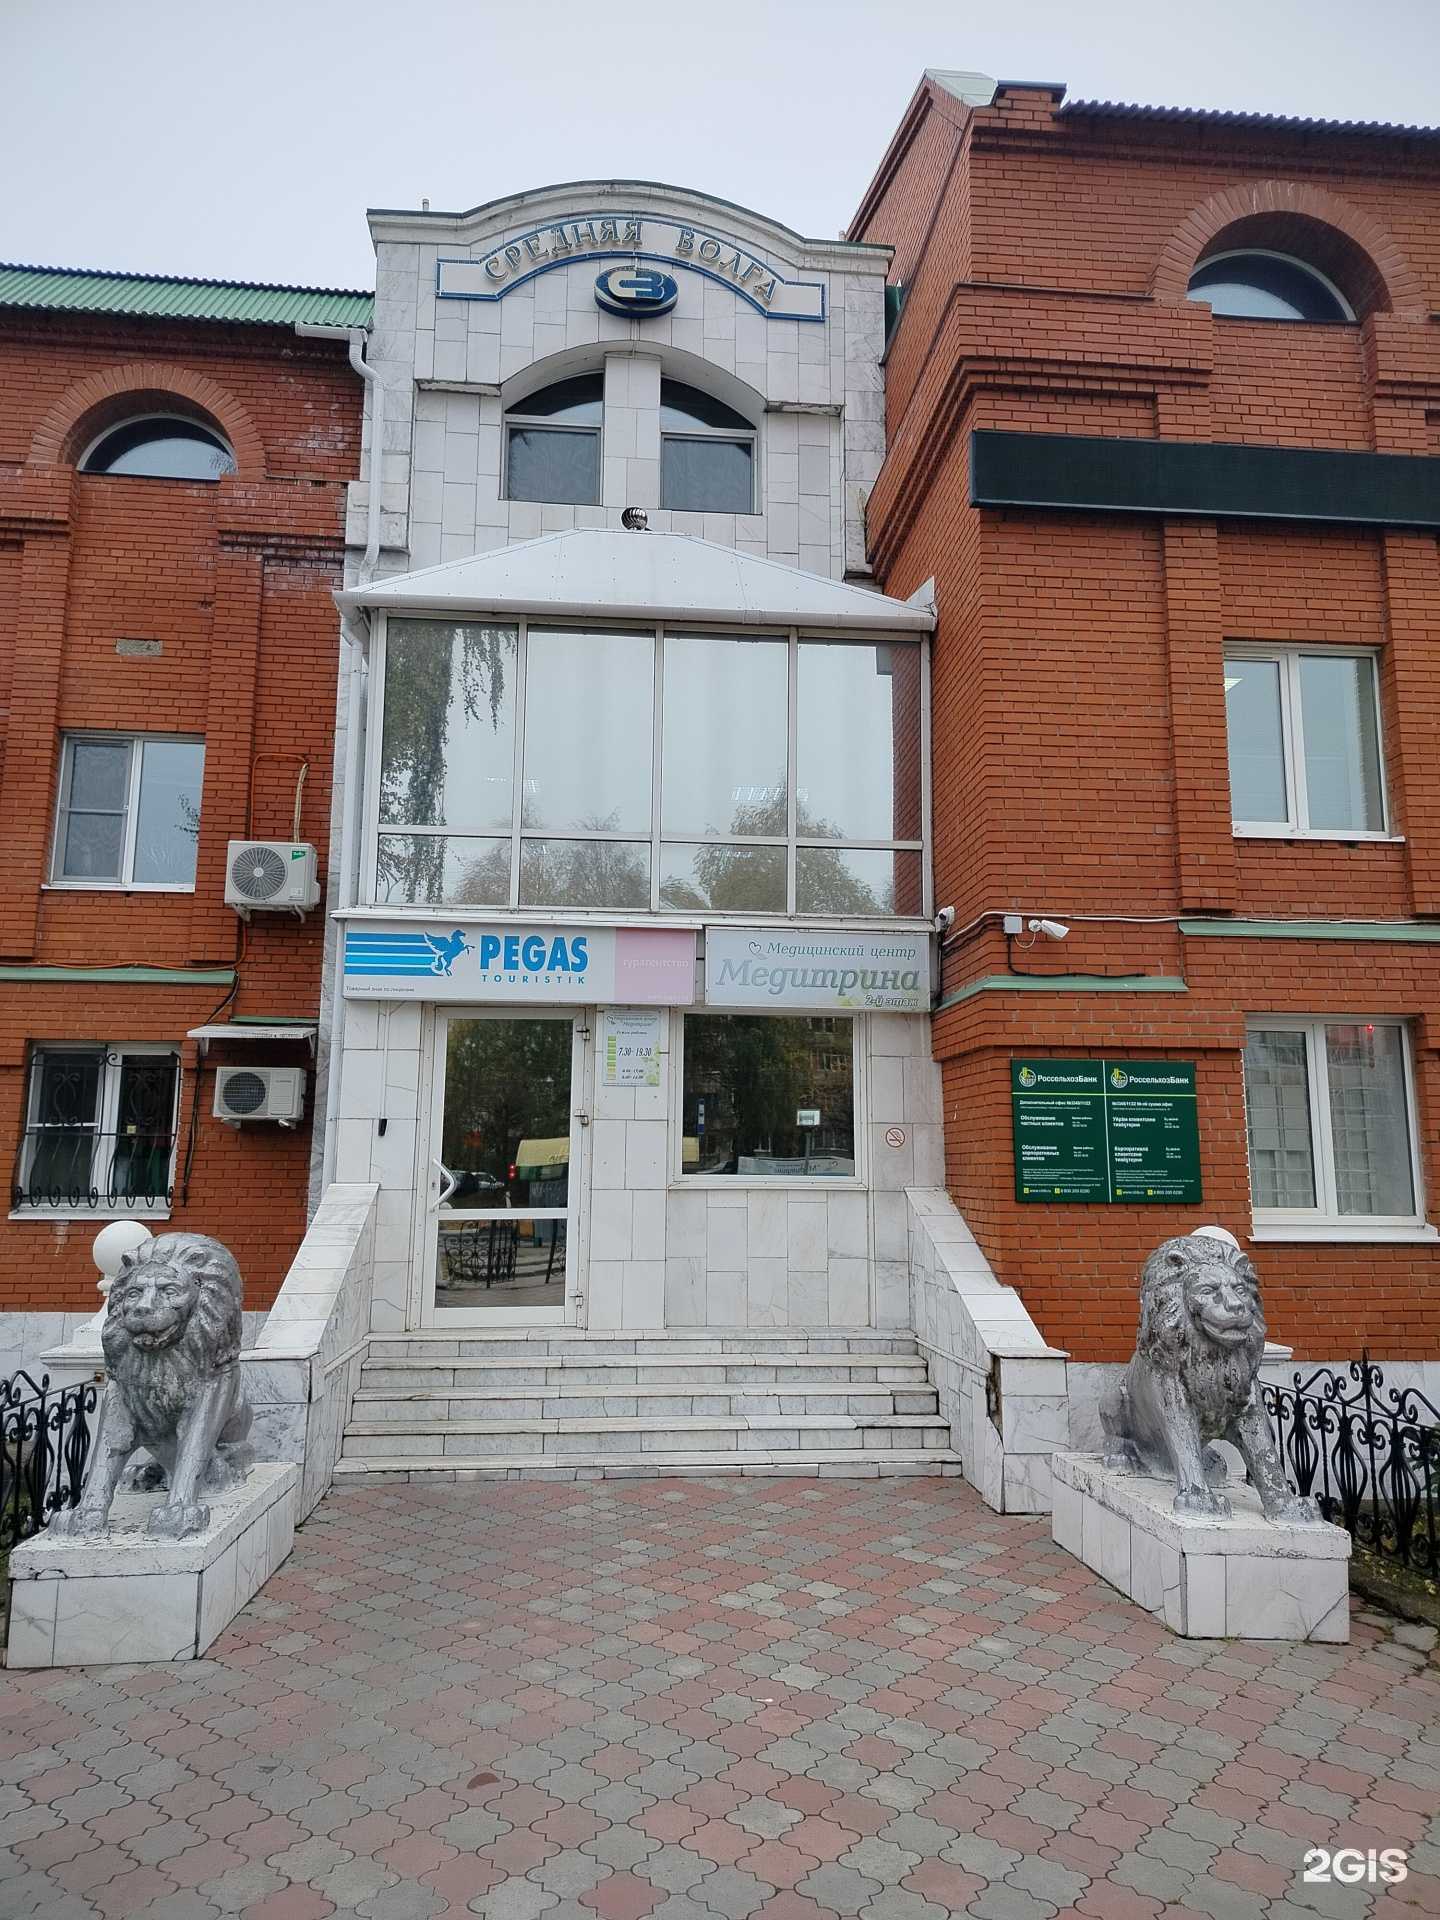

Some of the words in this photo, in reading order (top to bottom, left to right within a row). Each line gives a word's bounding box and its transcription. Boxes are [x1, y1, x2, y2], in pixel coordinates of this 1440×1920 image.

[484, 218, 644, 282] СРЕДНЯЯ
[676, 227, 777, 305] ВОЛГА
[480, 935, 589, 973] PEGAS
[767, 942, 865, 957] Медицинский
[870, 948, 916, 960] центр
[482, 974, 585, 984] TOURISTIK
[715, 958, 920, 996] Медитрина
[864, 994, 884, 1008] 2-й
[885, 996, 919, 1007] этаж
[1037, 1074, 1098, 1083] РоссельхозБанк
[1129, 1075, 1190, 1084] РоссельхозБанк
